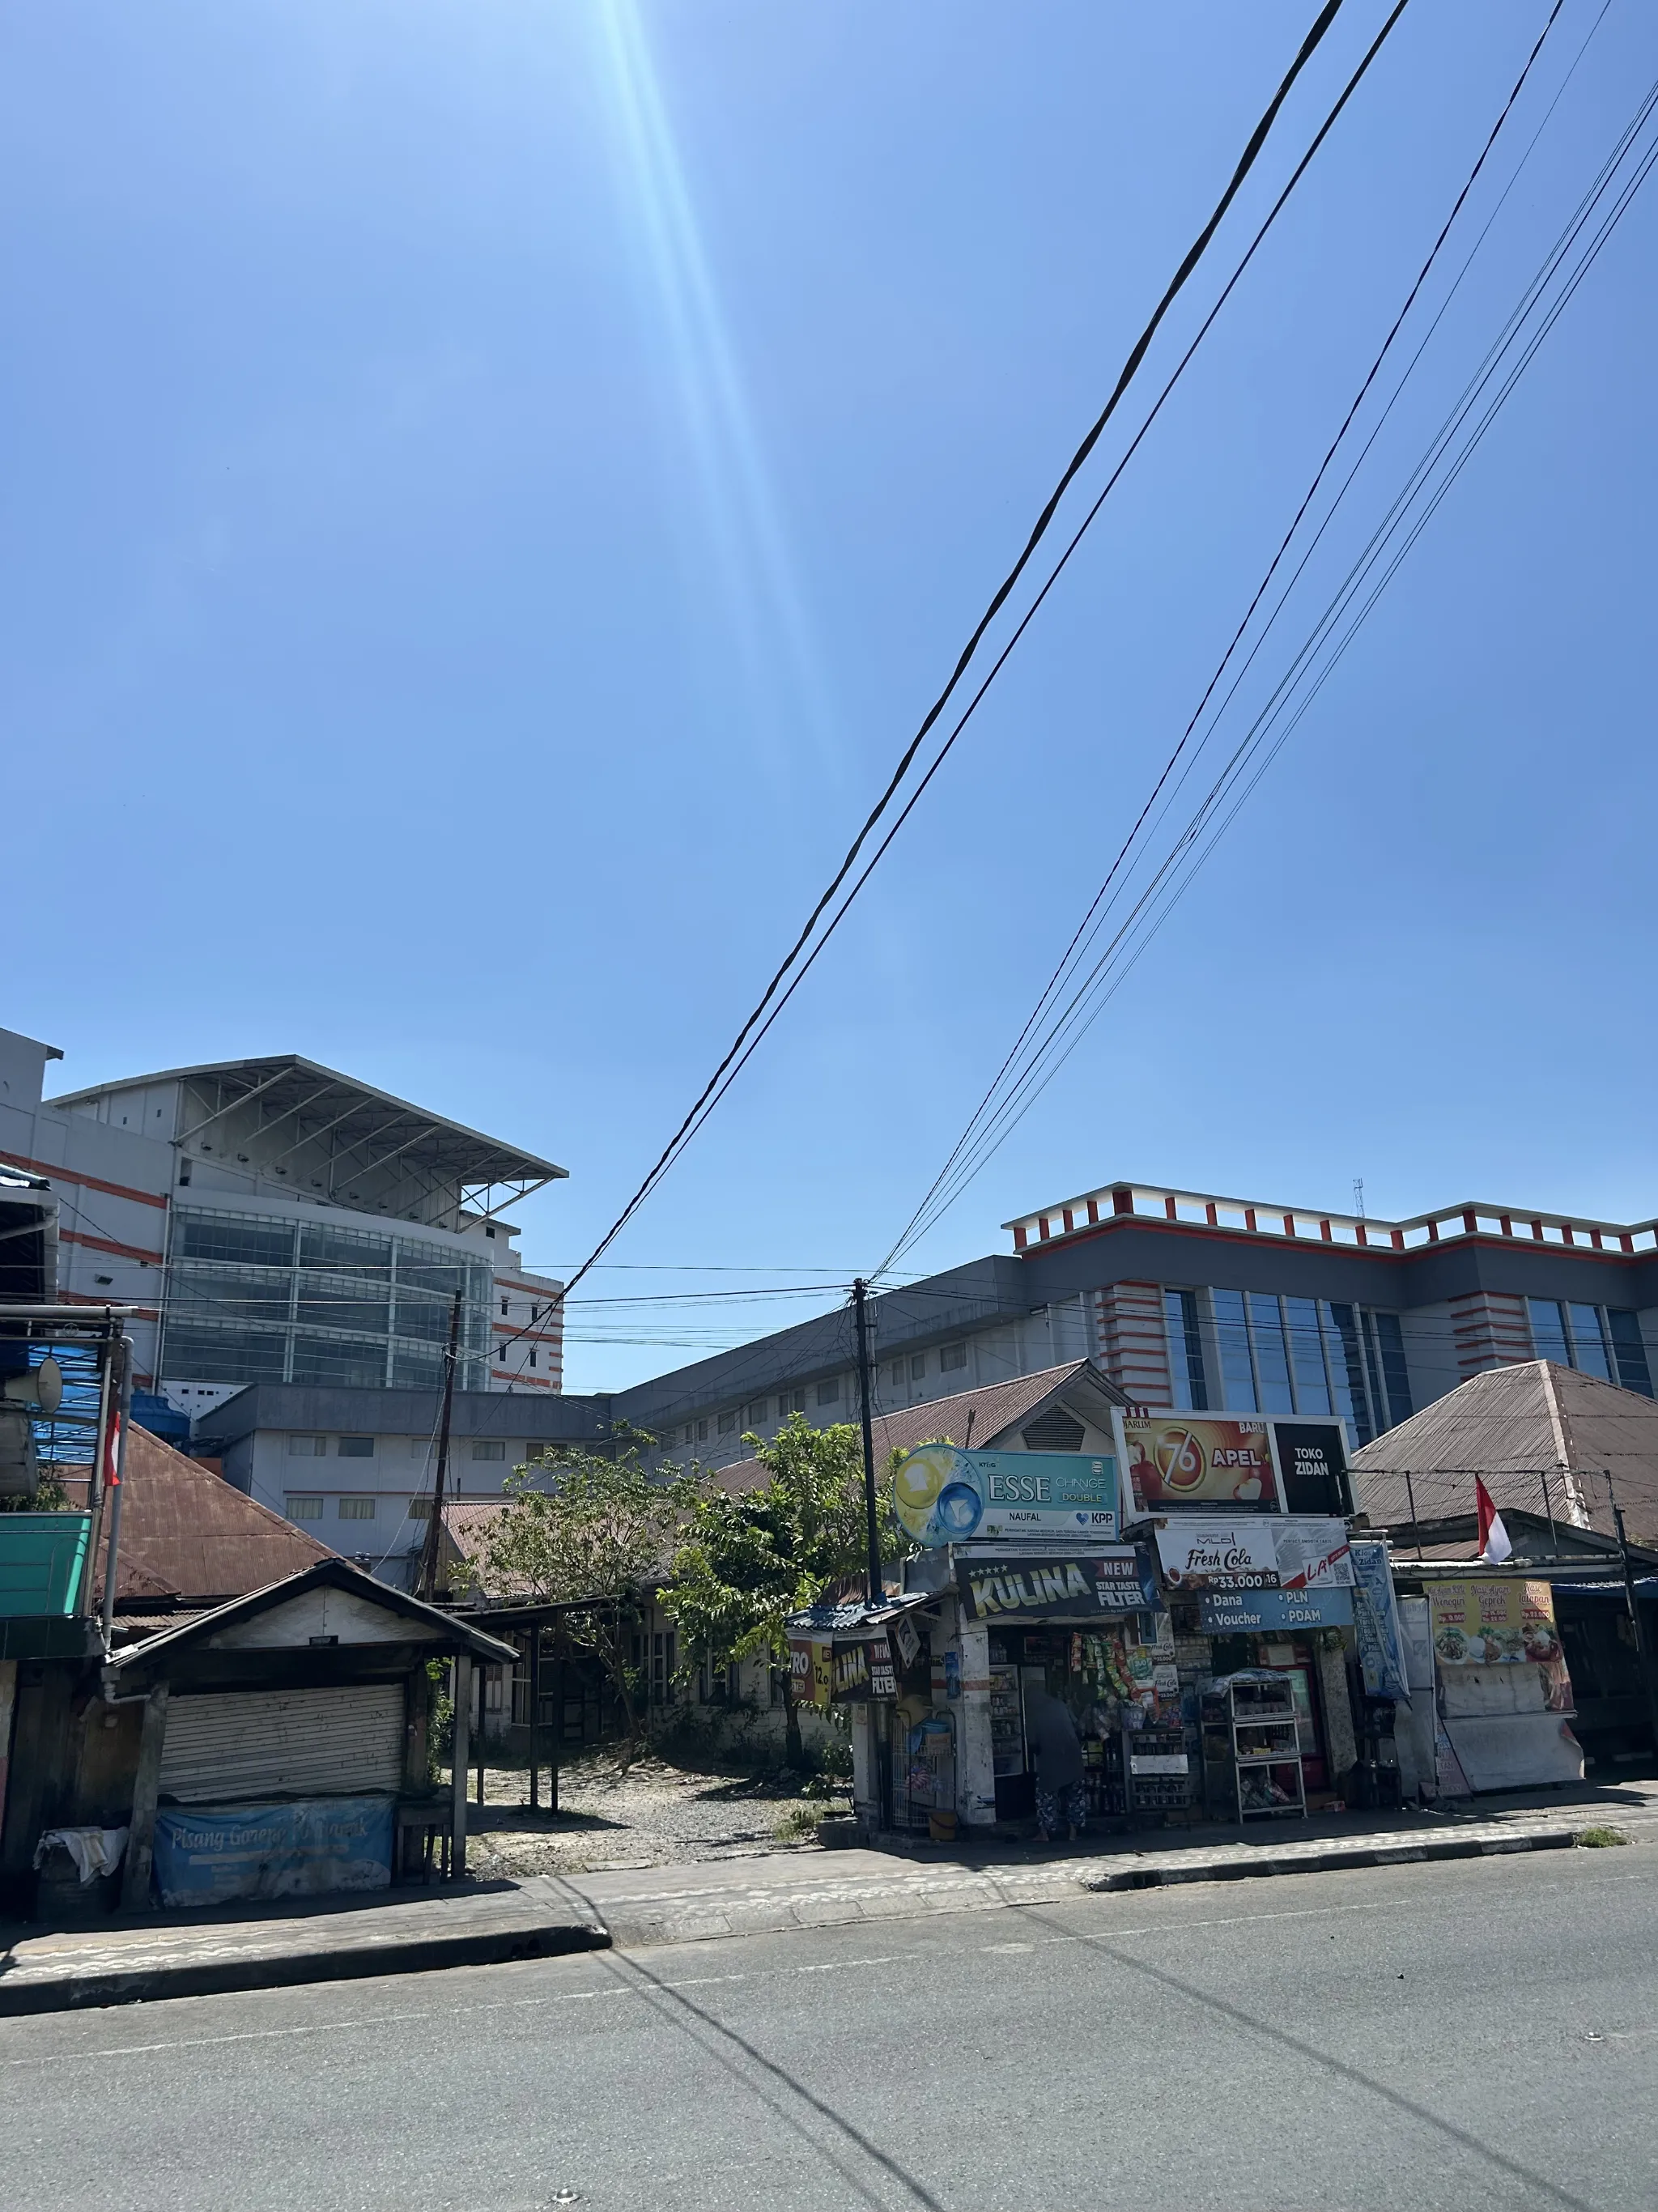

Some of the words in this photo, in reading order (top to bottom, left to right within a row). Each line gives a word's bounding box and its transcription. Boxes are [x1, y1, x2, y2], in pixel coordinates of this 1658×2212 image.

[1239, 1422, 1265, 1434] BARU
[1157, 1431, 1196, 1483] 76
[1213, 1448, 1261, 1467] APEL
[1295, 1448, 1324, 1460] TOKO
[1295, 1461, 1329, 1476] ZIDAN
[988, 1474, 1052, 1503] ESSE
[1056, 1477, 1107, 1491] CHANGE
[1062, 1493, 1103, 1503] DOUBLE
[1009, 1512, 1041, 1521] NAUFAL
[1091, 1512, 1113, 1524] KPP
[1197, 1537, 1232, 1545] MLD
[1185, 1549, 1221, 1570] Fresh
[1224, 1548, 1252, 1571] Cola
[1358, 1557, 1383, 1565] Zidan
[1103, 1562, 1133, 1576] NEW
[1095, 1582, 1116, 1590] STAR
[1117, 1581, 1141, 1590] TASTE
[1265, 1574, 1278, 1584] 16
[969, 1563, 1092, 1618] KULINA
[1471, 1585, 1487, 1595] Nasi
[1489, 1585, 1511, 1596] Ayam
[1098, 1591, 1146, 1606] FILTER
[1213, 1595, 1243, 1607] Dana
[1286, 1591, 1309, 1604] PLN
[1478, 1595, 1506, 1607] Geprek
[1215, 1613, 1261, 1626] Voucher
[1288, 1610, 1321, 1623] PDAM
[874, 1644, 891, 1658] NEW
[172, 1827, 224, 1852] Pisang
